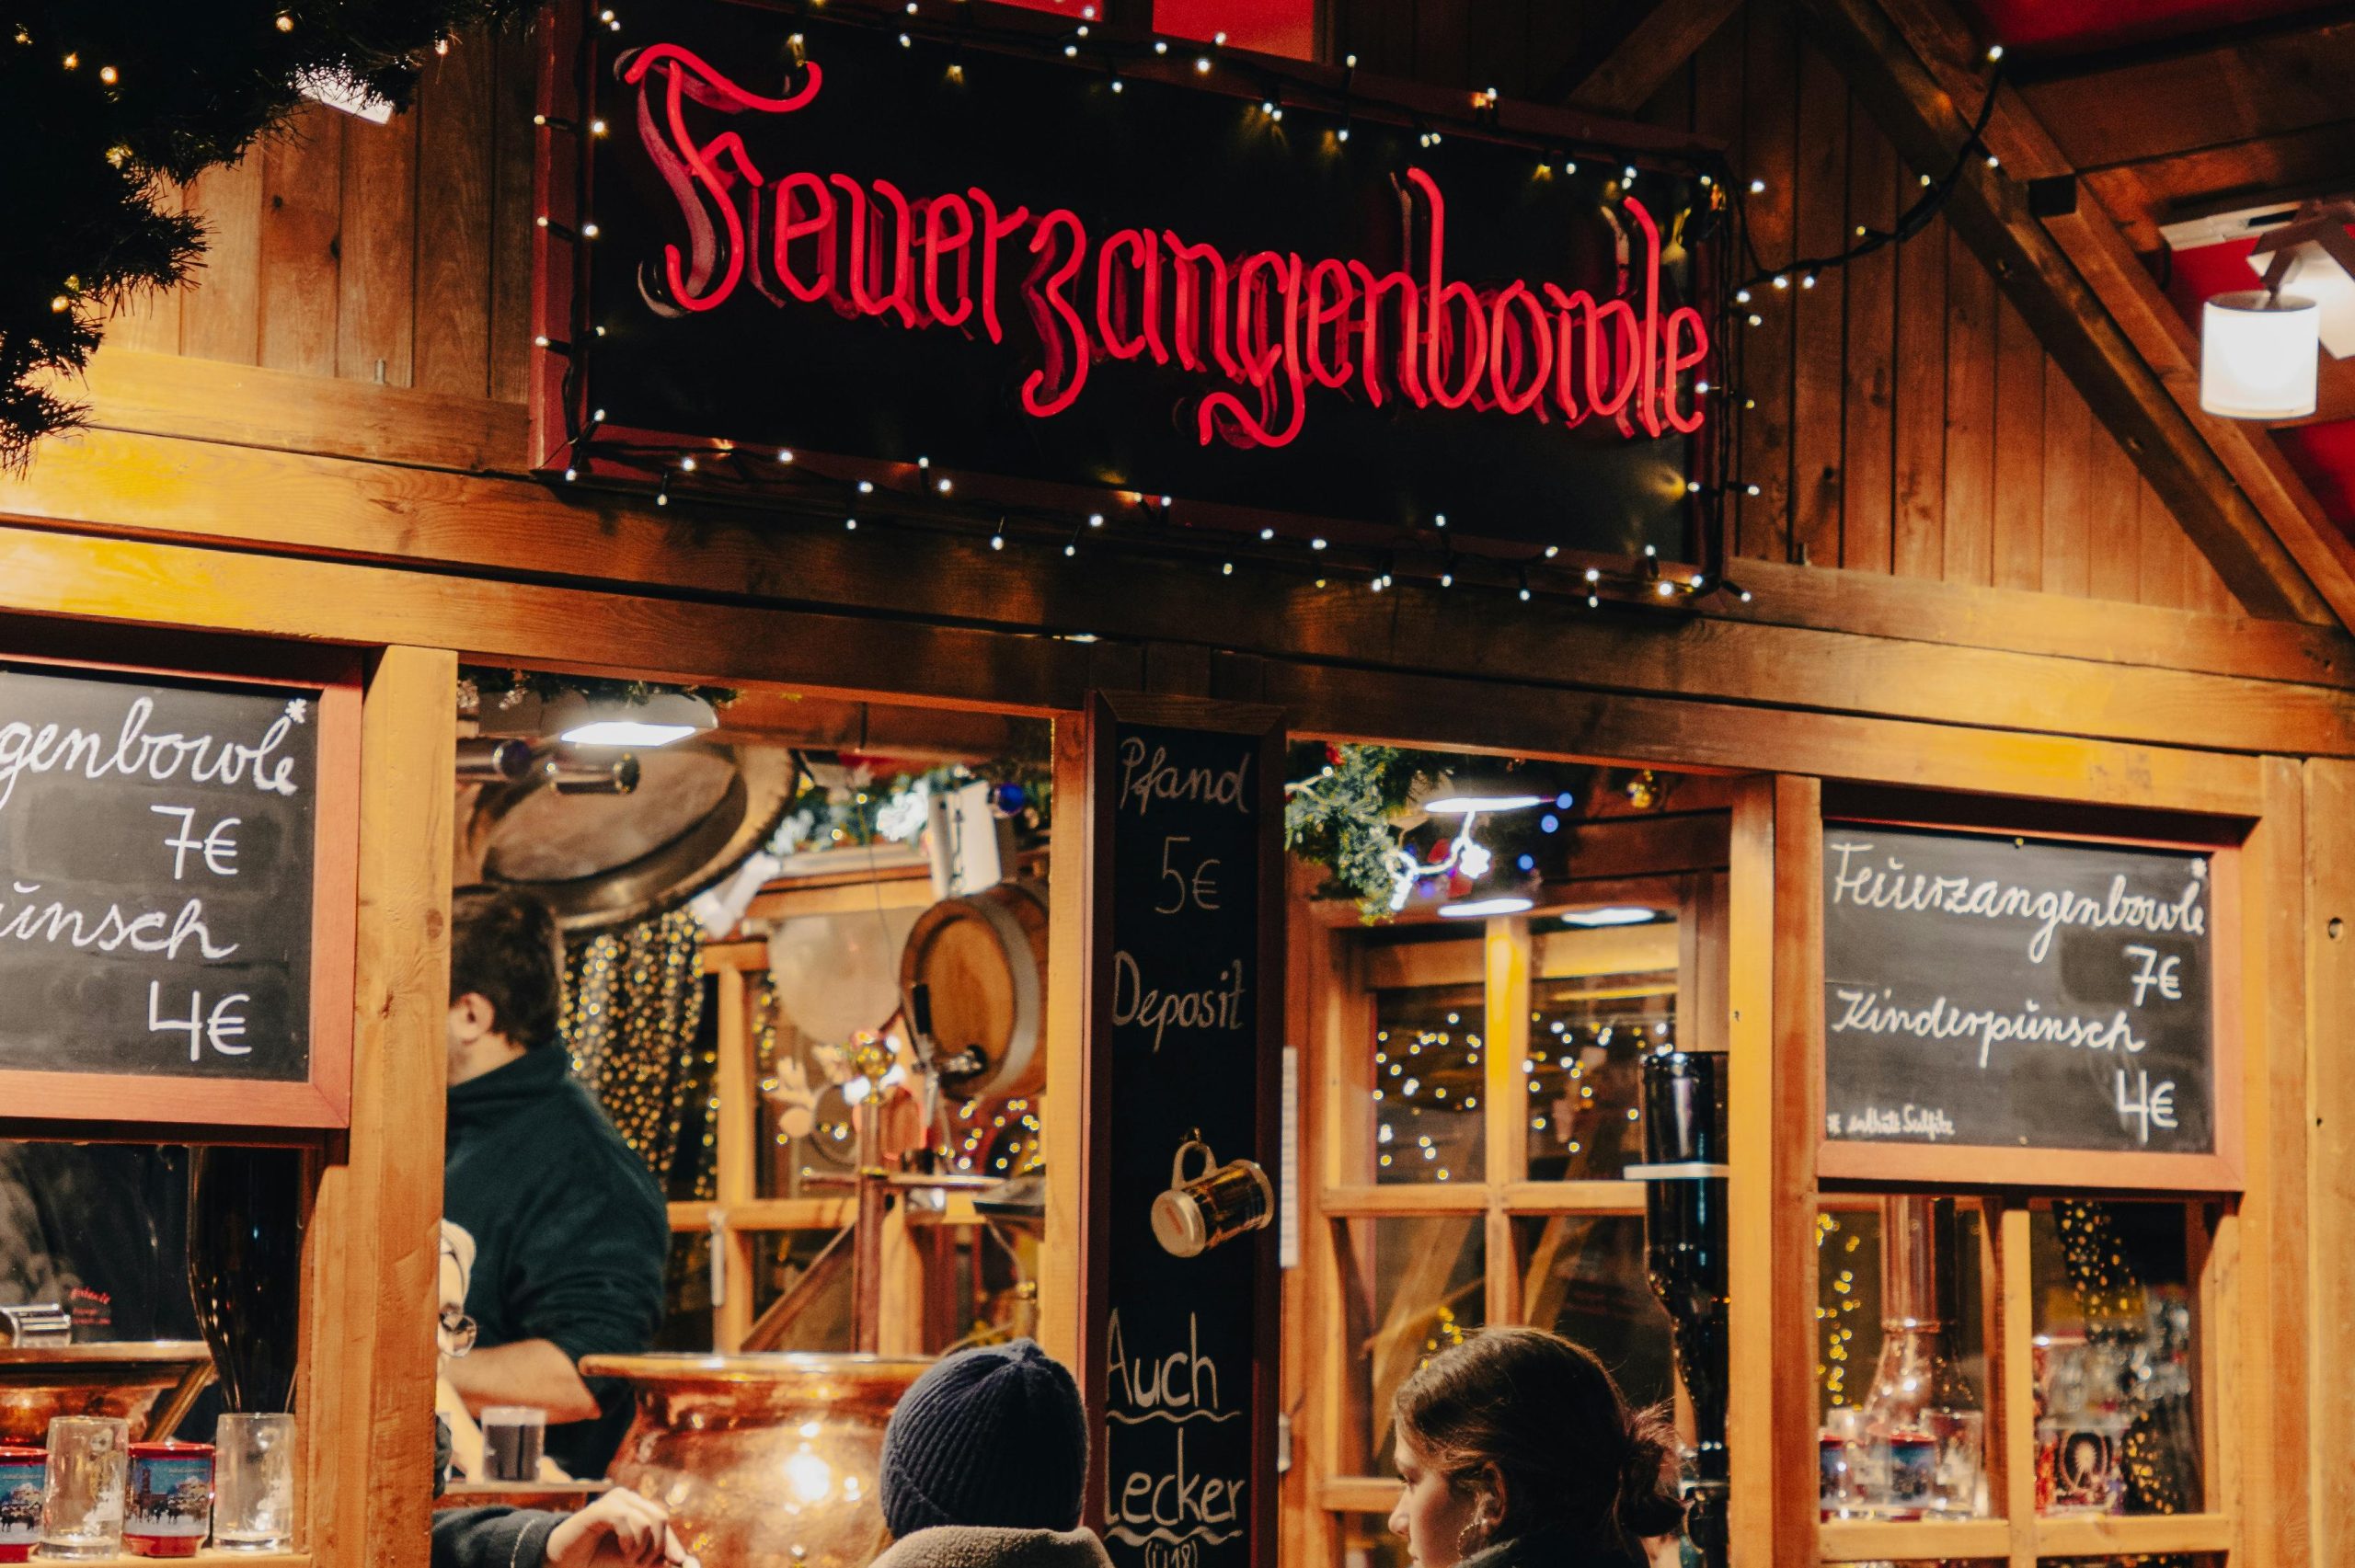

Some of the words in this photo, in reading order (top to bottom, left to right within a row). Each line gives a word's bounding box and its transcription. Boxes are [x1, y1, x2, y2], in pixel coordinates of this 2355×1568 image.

[620, 42, 1711, 446] Feuerzangenbowle
[1120, 737, 1250, 816] Pfand
[151, 805, 241, 879] 7€
[1155, 837, 1221, 913] 5€
[1111, 950, 1246, 1053] Deposit
[2123, 944, 2182, 1006] 7€
[149, 980, 252, 1060] 4€
[2117, 1070, 2178, 1143] 4€
[1106, 1308, 1218, 1410] Auch
[1105, 1425, 1246, 1527] Lecker
